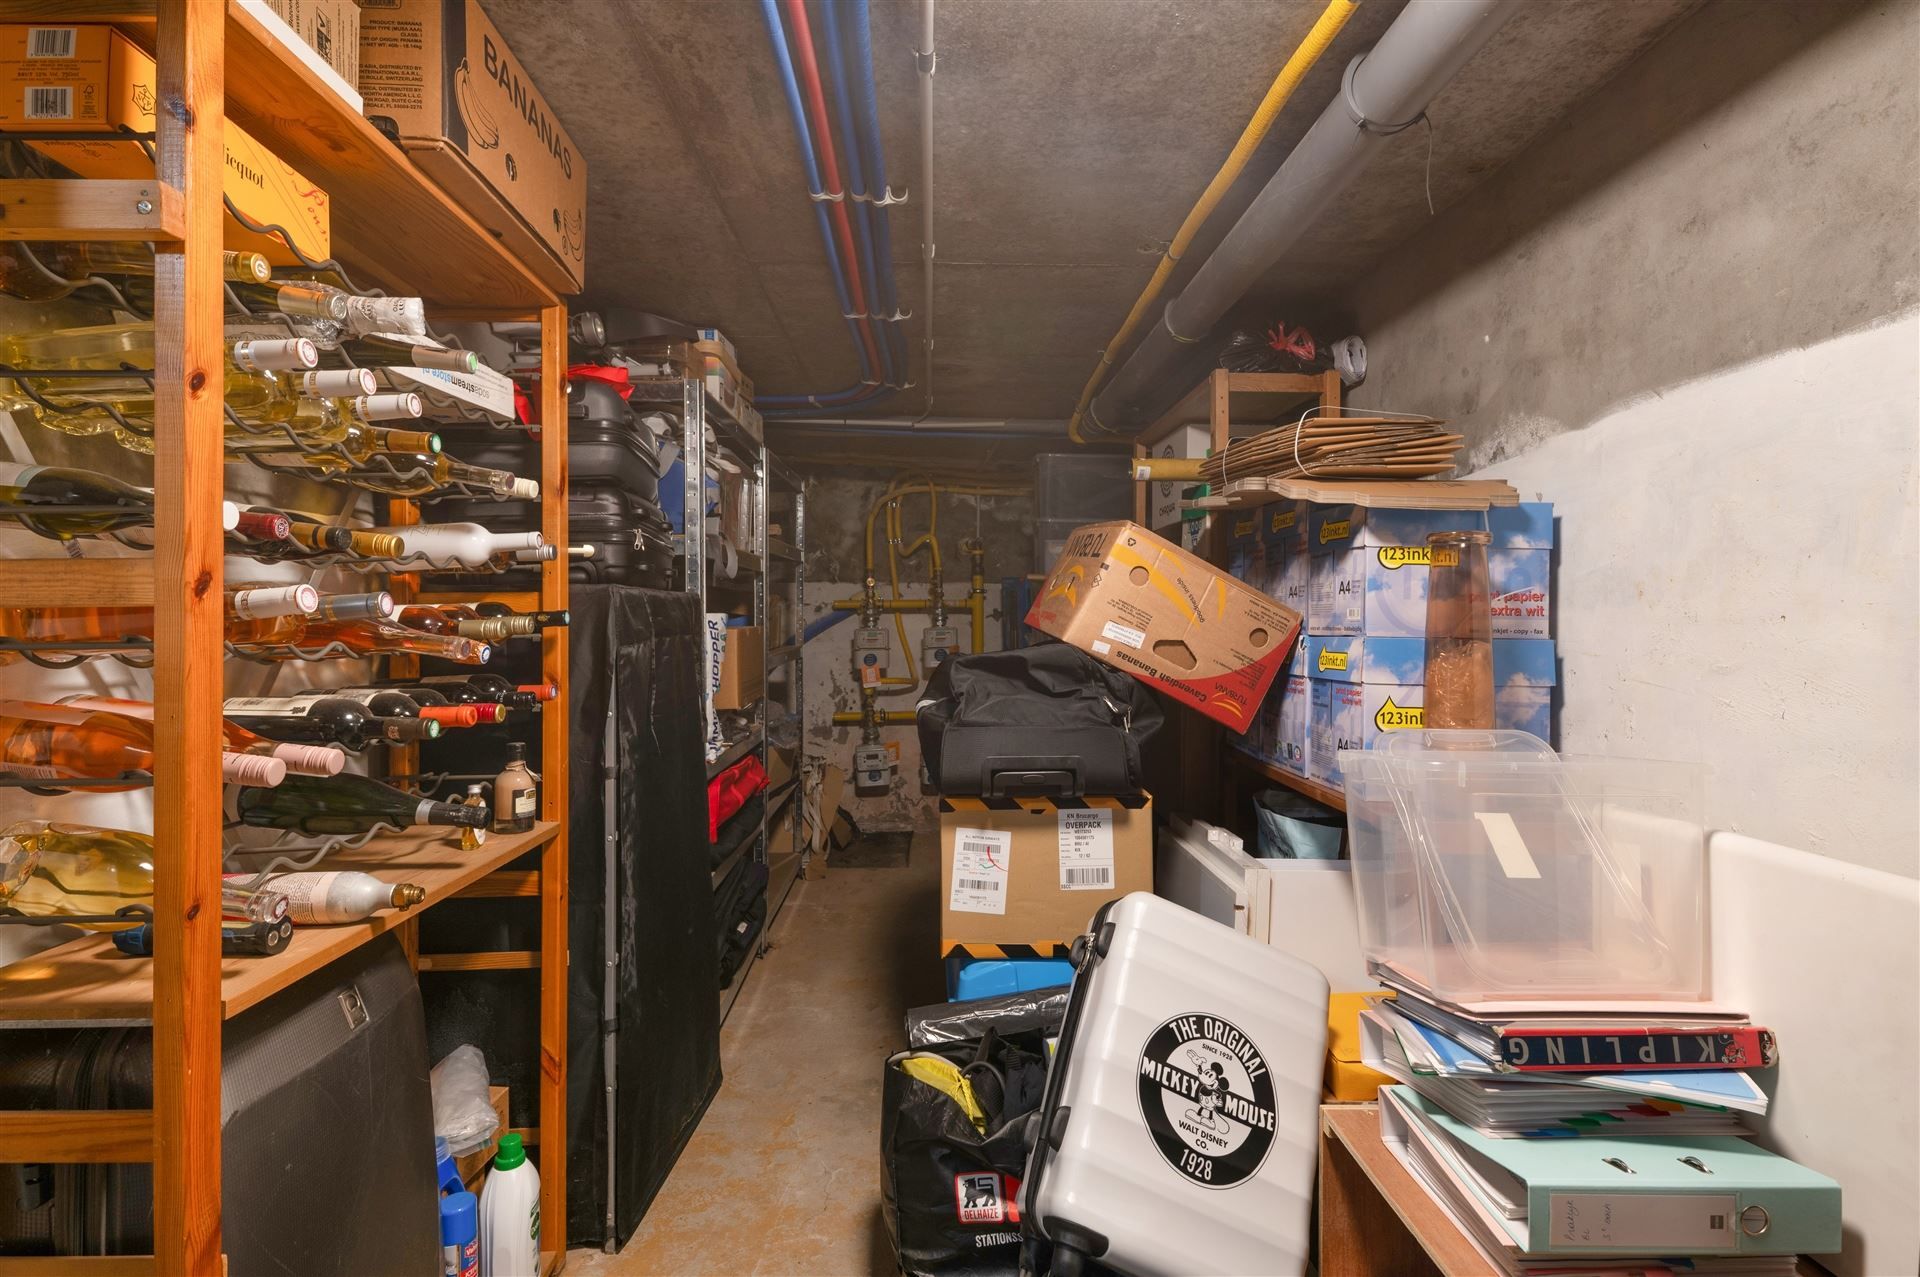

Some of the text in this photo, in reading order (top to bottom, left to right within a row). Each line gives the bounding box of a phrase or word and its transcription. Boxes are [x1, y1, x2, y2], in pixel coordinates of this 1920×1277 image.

[484, 34, 572, 180] BANANAS
[222, 144, 264, 189] icquot
[1321, 524, 1349, 539] 123inkt.nl
[1288, 585, 1298, 598] A4
[1338, 580, 1351, 595] A4
[1504, 591, 1545, 604] papier
[1490, 605, 1545, 617] extra wit
[1513, 628, 1528, 636] copy
[1533, 627, 1544, 635] fax
[708, 619, 720, 695] HOPPER
[1116, 650, 1158, 677] Bananas
[1320, 654, 1346, 668] 123inkt.nl
[1159, 668, 1208, 703] Cavendish
[1337, 738, 1349, 751] A4
[1065, 821, 1102, 829] OVERPACK
[1169, 1016, 1266, 1083] THE ORIGINAL
[1201, 1043, 1233, 1062] SINCE 1928
[1509, 1036, 1716, 1065] KIPLING
[1141, 1055, 1275, 1132] MICKEY MOUSE
[1178, 1119, 1229, 1148] WALT DISNEY
[1195, 1138, 1209, 1151] CO.
[1179, 1149, 1213, 1181] 1928
[963, 1208, 999, 1220] DELHAIZE
